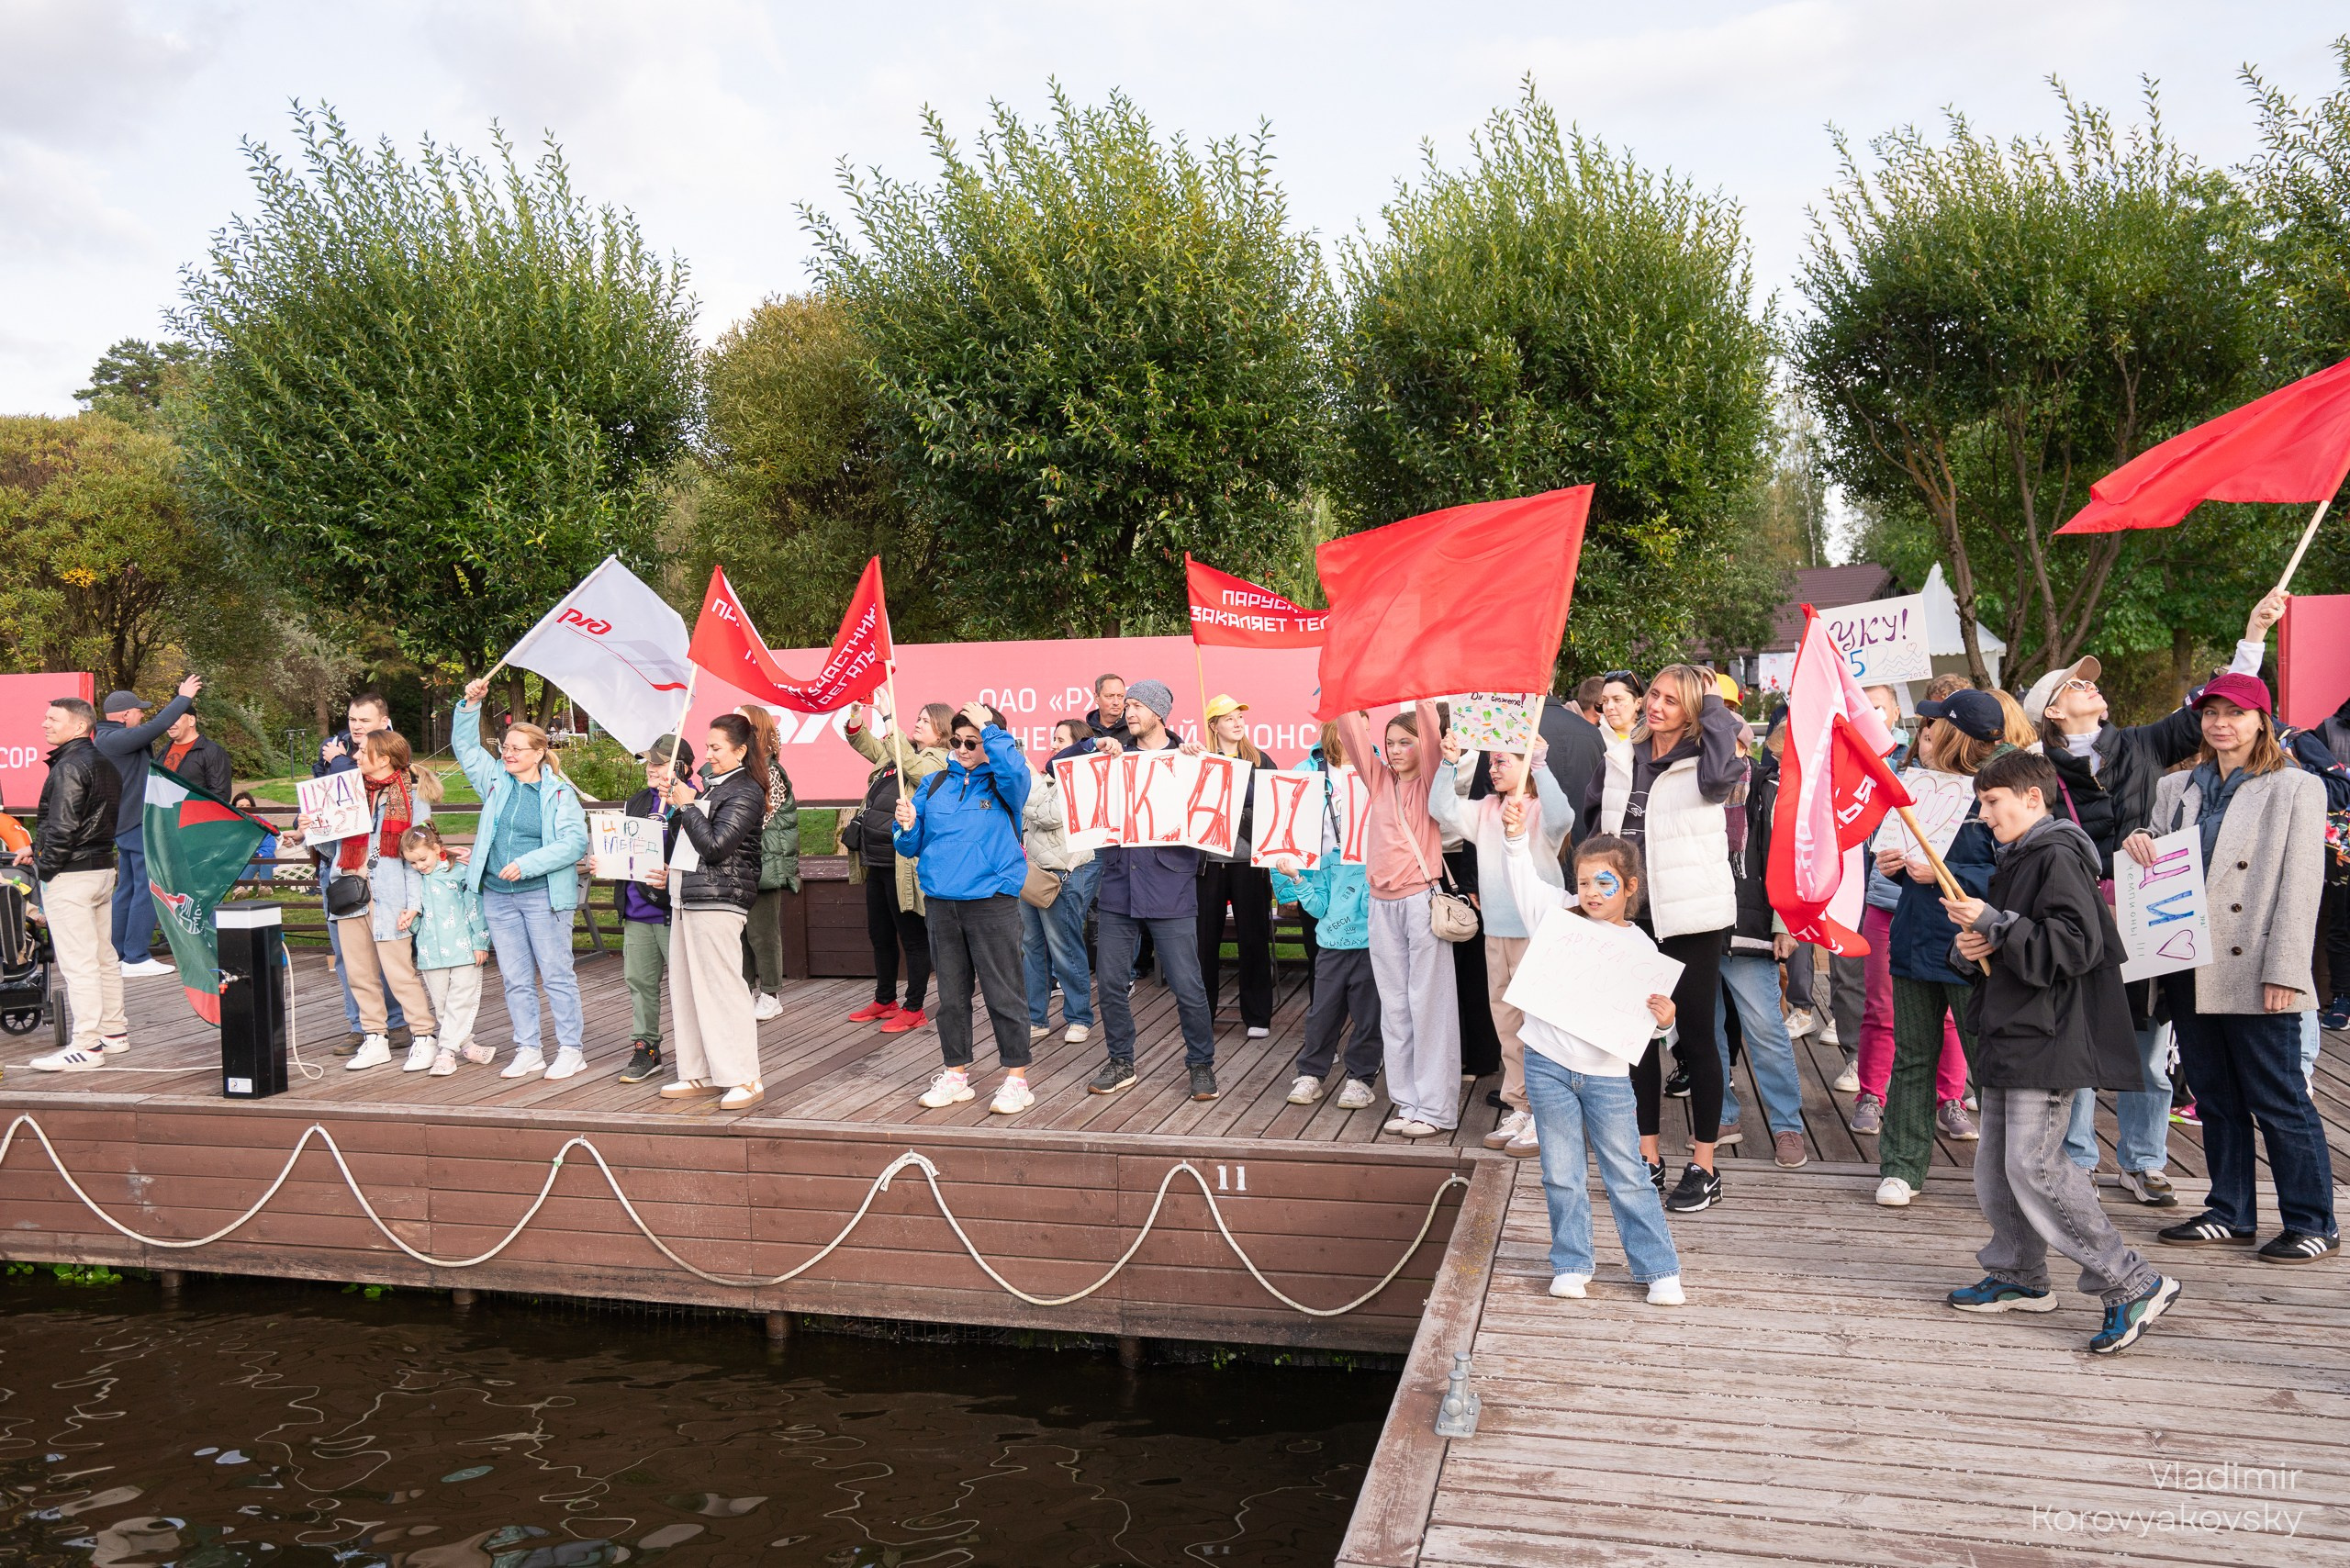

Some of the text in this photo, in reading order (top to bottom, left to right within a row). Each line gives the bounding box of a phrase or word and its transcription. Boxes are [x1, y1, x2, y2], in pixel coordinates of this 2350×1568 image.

[1191, 605, 1288, 633] ЗАКАЛЯЕТ
[1829, 608, 1908, 652] УКУ!
[1217, 1165, 1247, 1191] 11
